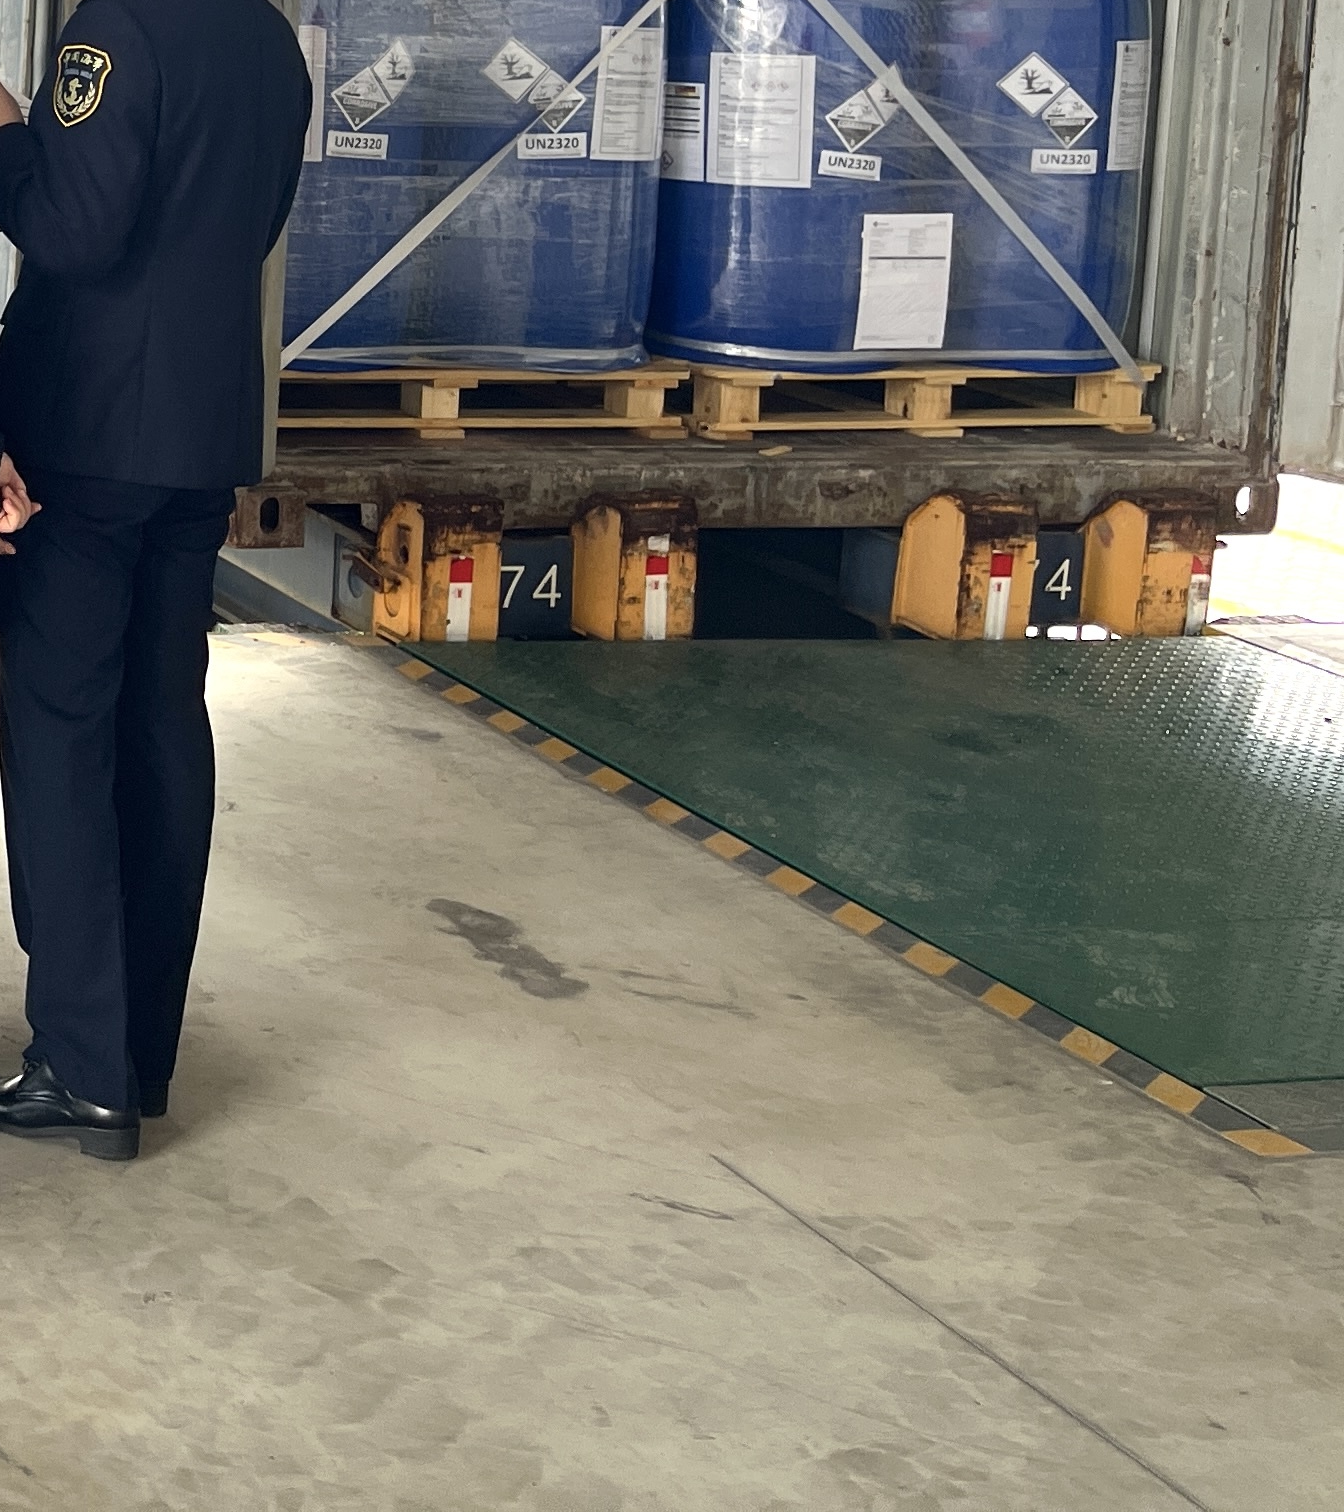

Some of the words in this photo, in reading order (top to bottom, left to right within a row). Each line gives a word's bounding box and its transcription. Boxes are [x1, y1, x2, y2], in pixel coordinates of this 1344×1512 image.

[335, 135, 383, 150] UN2320
[525, 137, 579, 150] UN2320
[828, 155, 876, 171] UN2320
[1040, 153, 1091, 165] UN2320
[500, 563, 562, 609] 74
[1034, 558, 1072, 601] 4
